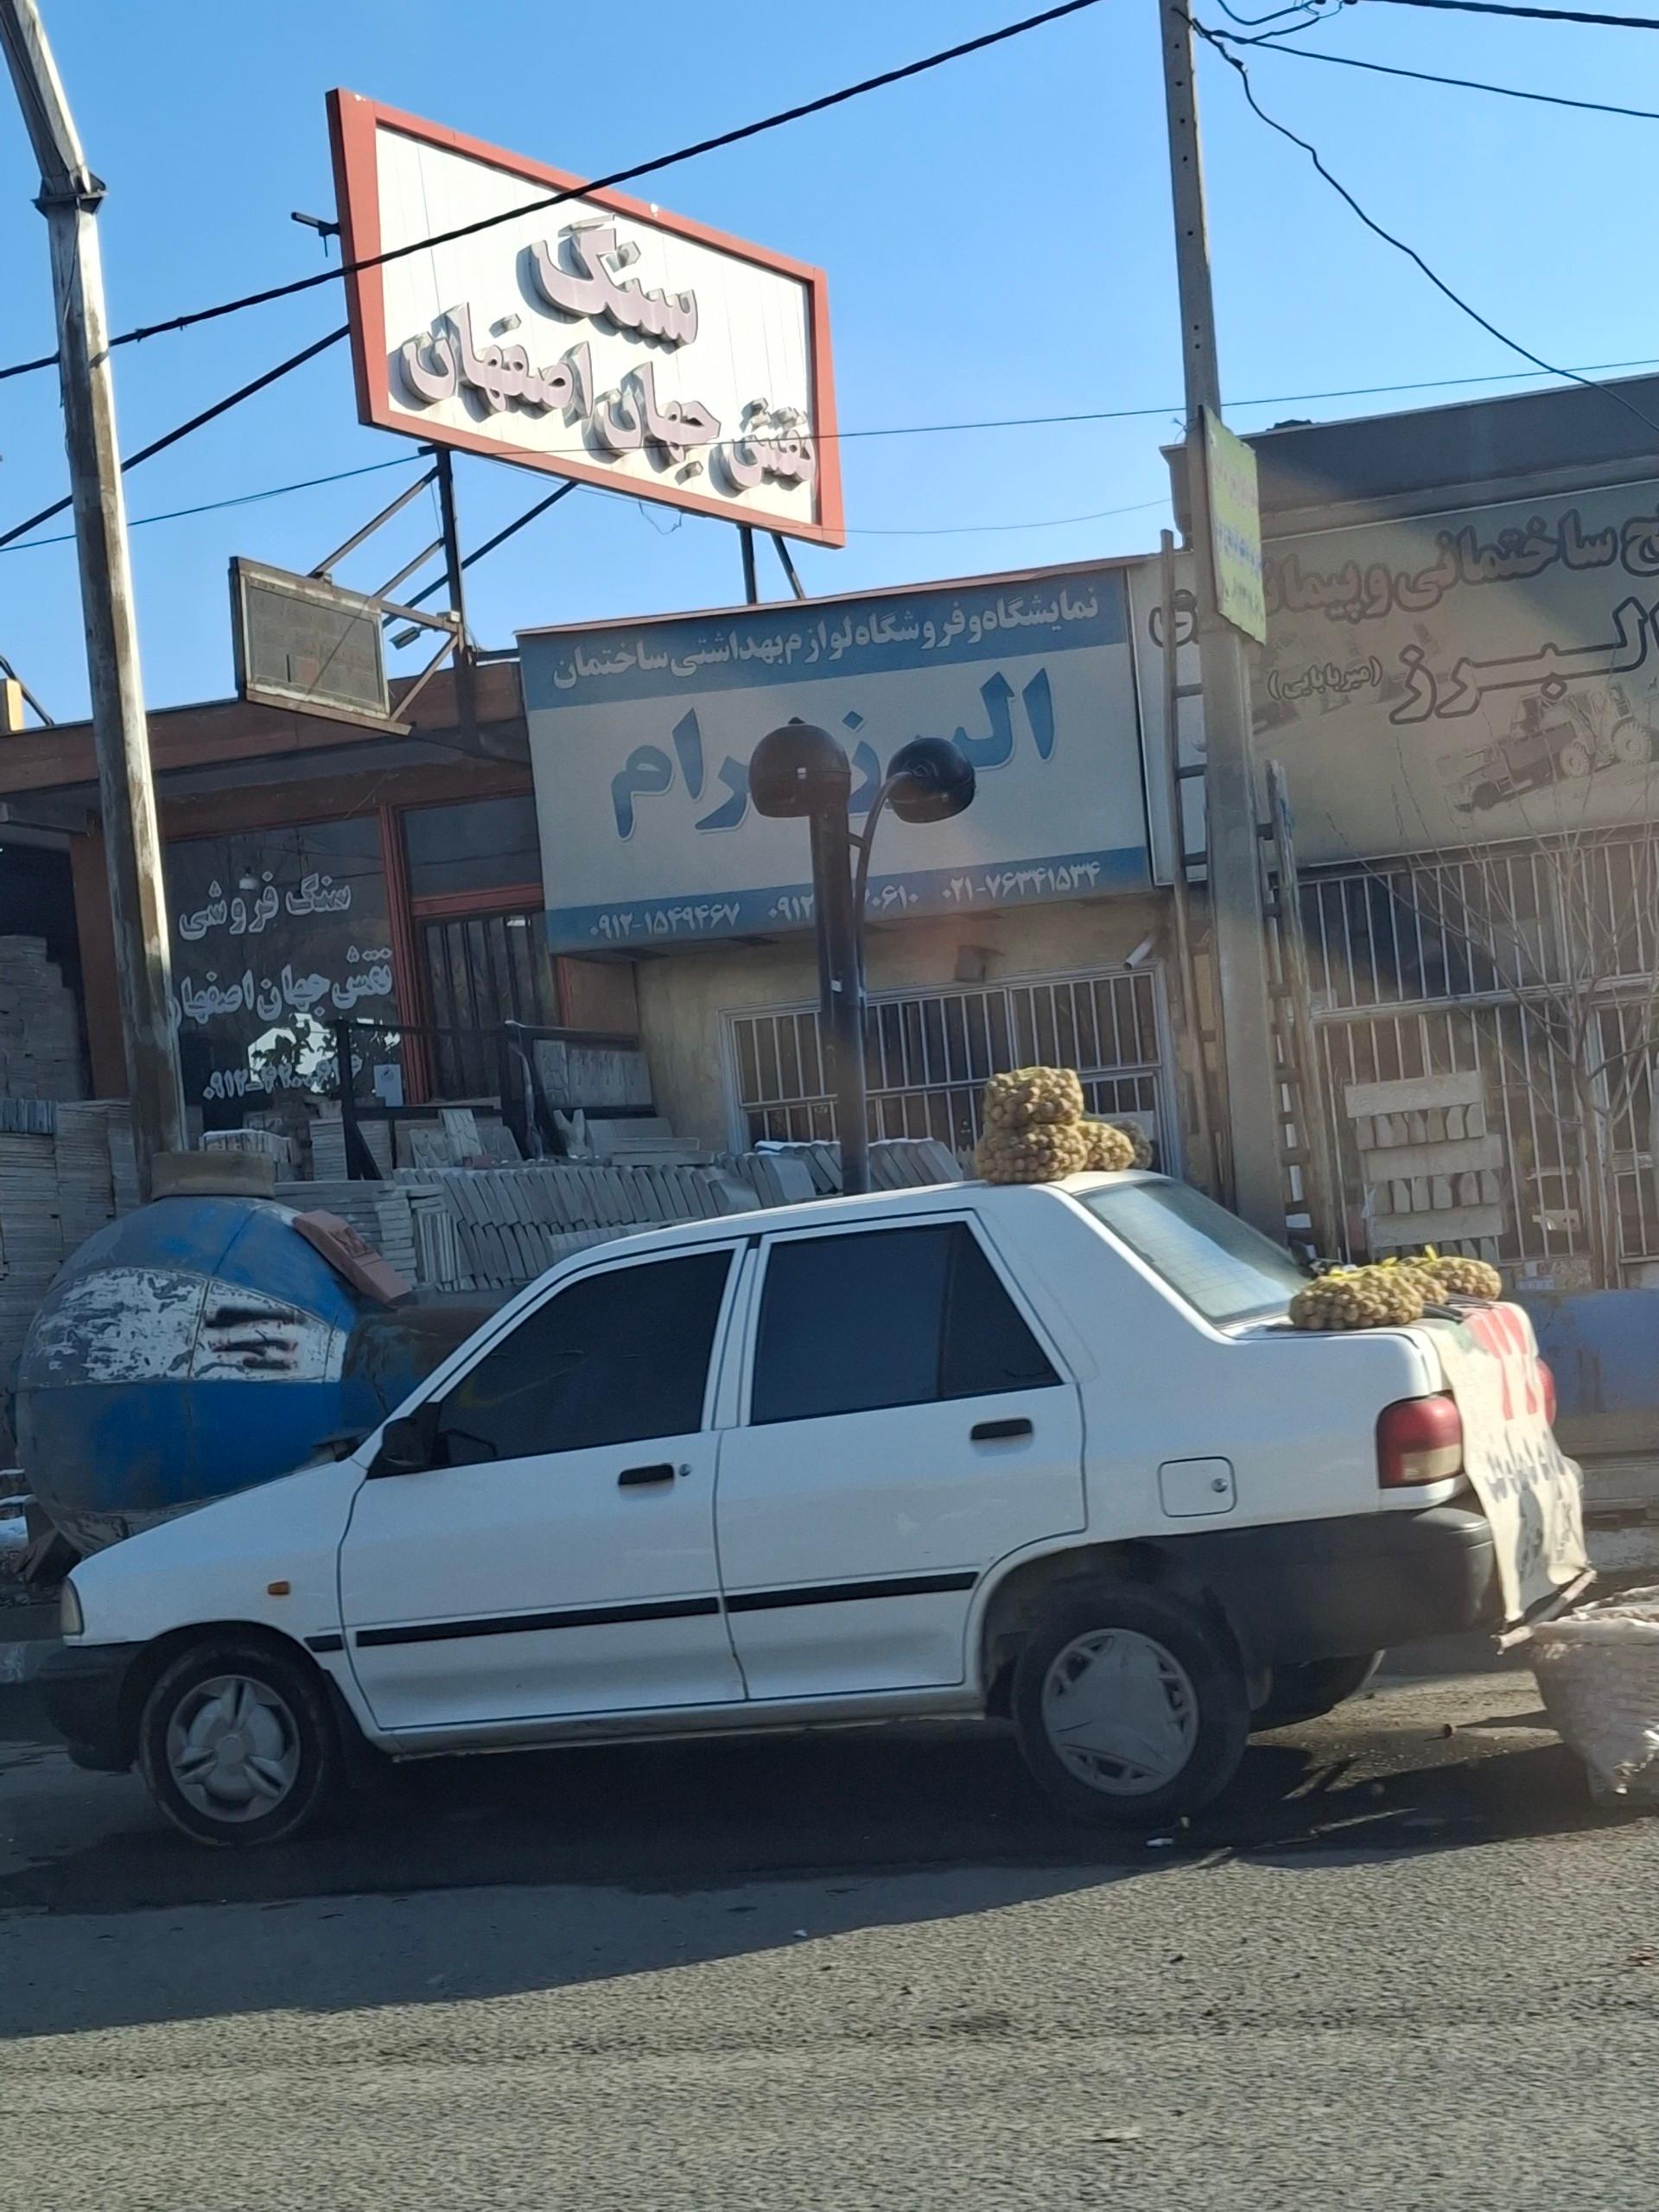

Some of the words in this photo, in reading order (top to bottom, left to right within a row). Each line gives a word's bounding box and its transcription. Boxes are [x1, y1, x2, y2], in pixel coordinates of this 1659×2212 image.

[518, 213, 699, 347] سنگ
[393, 301, 594, 423] اصفهان
[589, 361, 721, 485] جهان
[717, 397, 816, 493] نقش
[1394, 508, 1618, 613] ساختمانی
[855, 601, 967, 650] فروشگاه
[967, 612, 983, 645] و
[982, 587, 1099, 632] نمایشگاه
[552, 639, 669, 690] ساختمان
[670, 629, 784, 677] بهداشتی
[784, 614, 853, 665] لوازم
[179, 871, 278, 940] فروشی
[285, 873, 351, 916] سنگ
[257, 964, 331, 1021] جهان
[332, 945, 392, 1010] نقش
